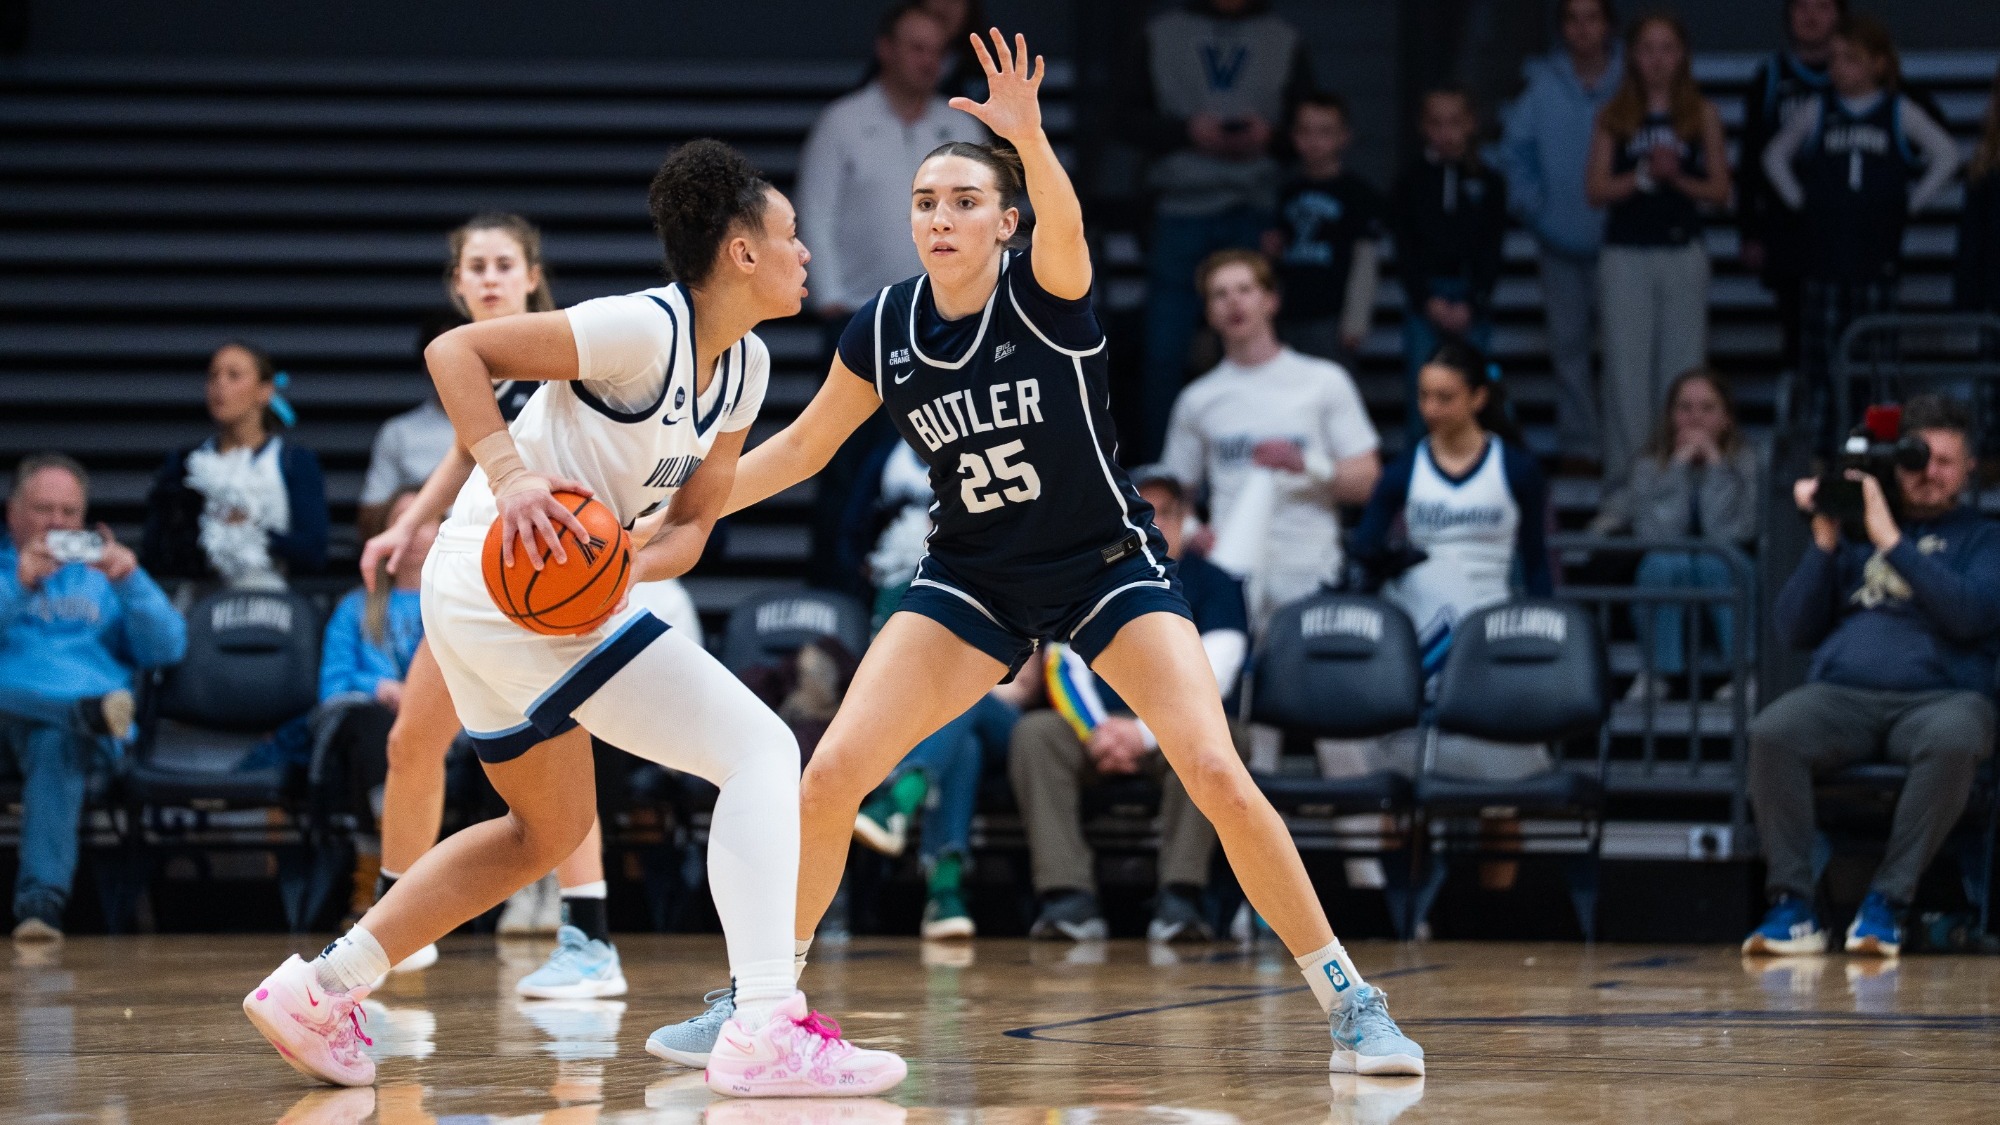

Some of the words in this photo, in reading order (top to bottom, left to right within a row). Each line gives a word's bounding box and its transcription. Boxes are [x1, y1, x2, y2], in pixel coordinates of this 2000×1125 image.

[890, 350, 899, 359] BE
[907, 378, 1044, 452] BUTLER
[957, 439, 1041, 514] 25
[839, 1074, 855, 1085] 20
